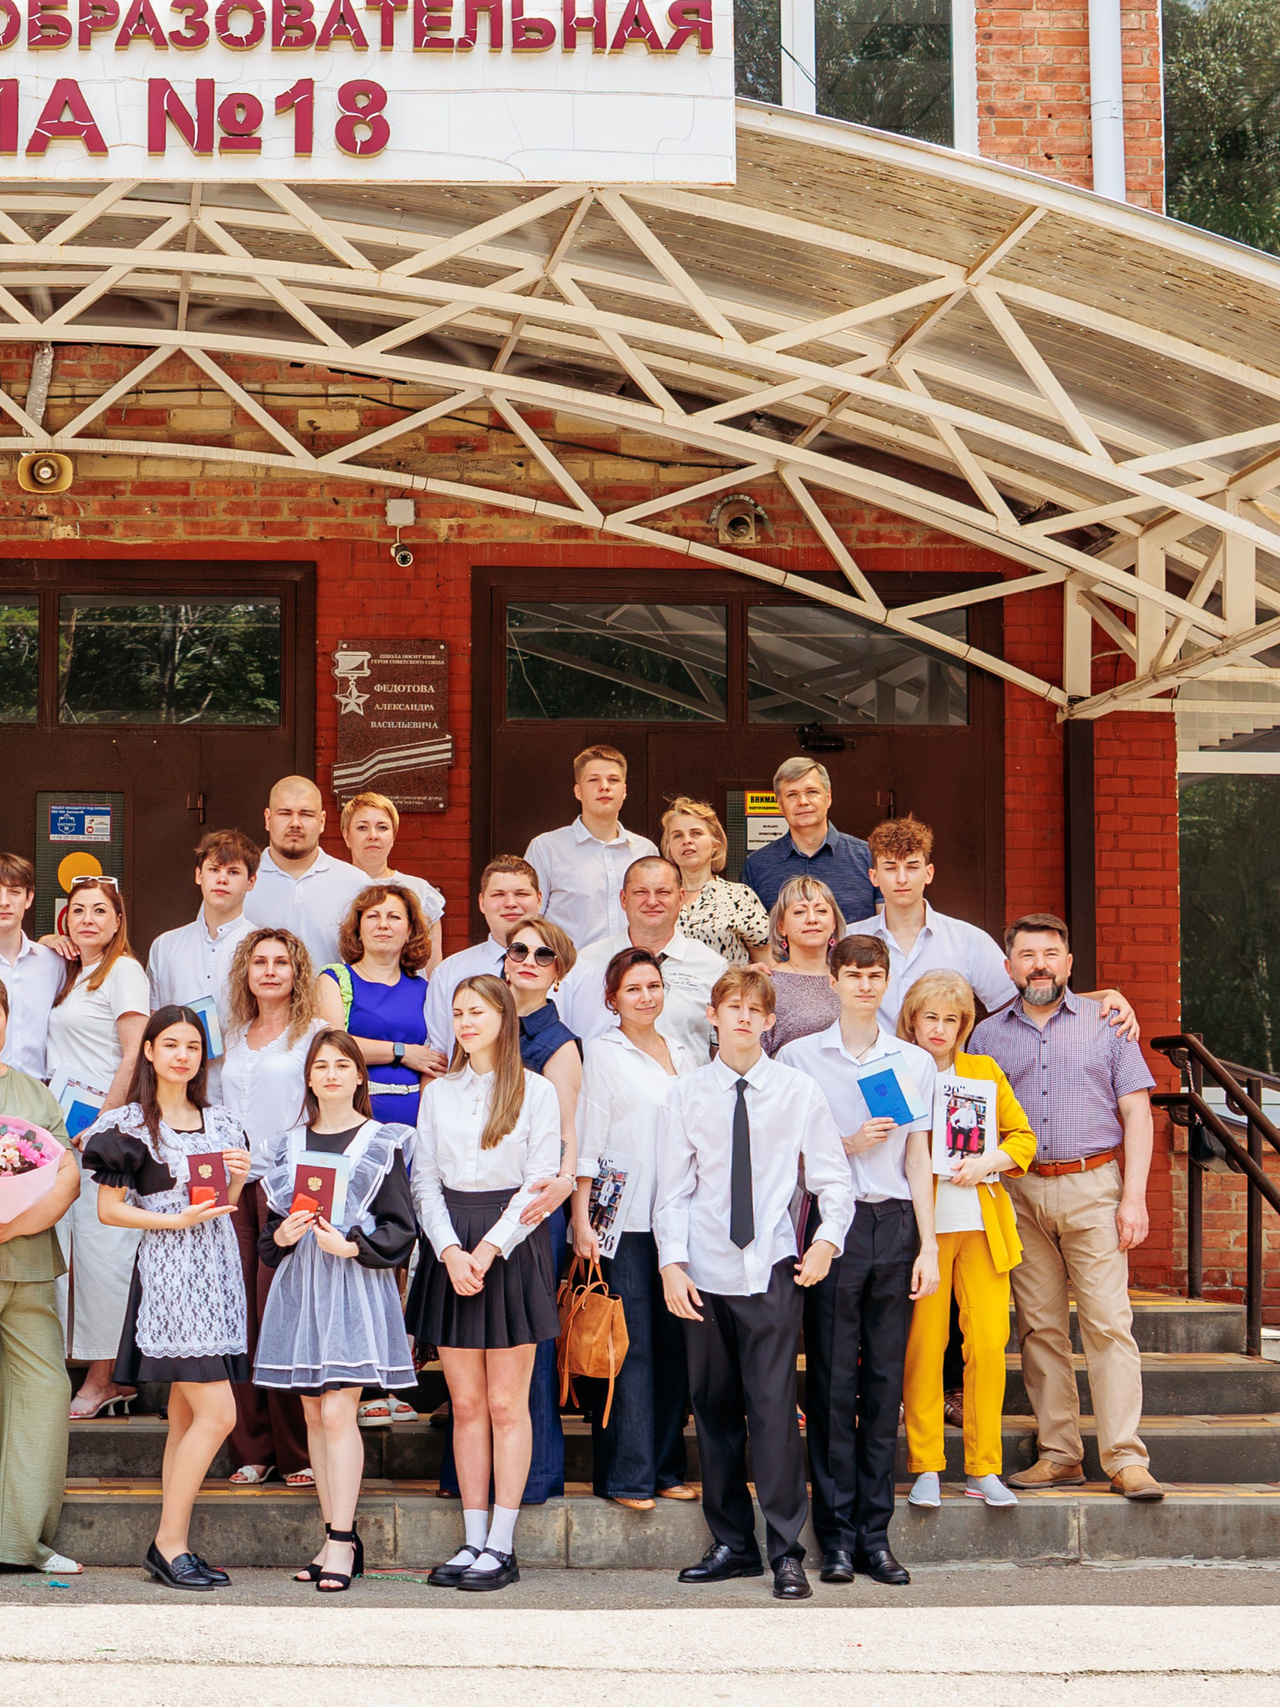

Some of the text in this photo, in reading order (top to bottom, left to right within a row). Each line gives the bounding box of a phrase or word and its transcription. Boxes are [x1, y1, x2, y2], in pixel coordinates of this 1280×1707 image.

[147, 77, 391, 159] №18
[373, 684, 436, 693] ФЕДОТОВА
[373, 703, 435, 712] АЛЕКСАНДРА
[370, 721, 439, 729] ВАСИЛЬЕВИЧА
